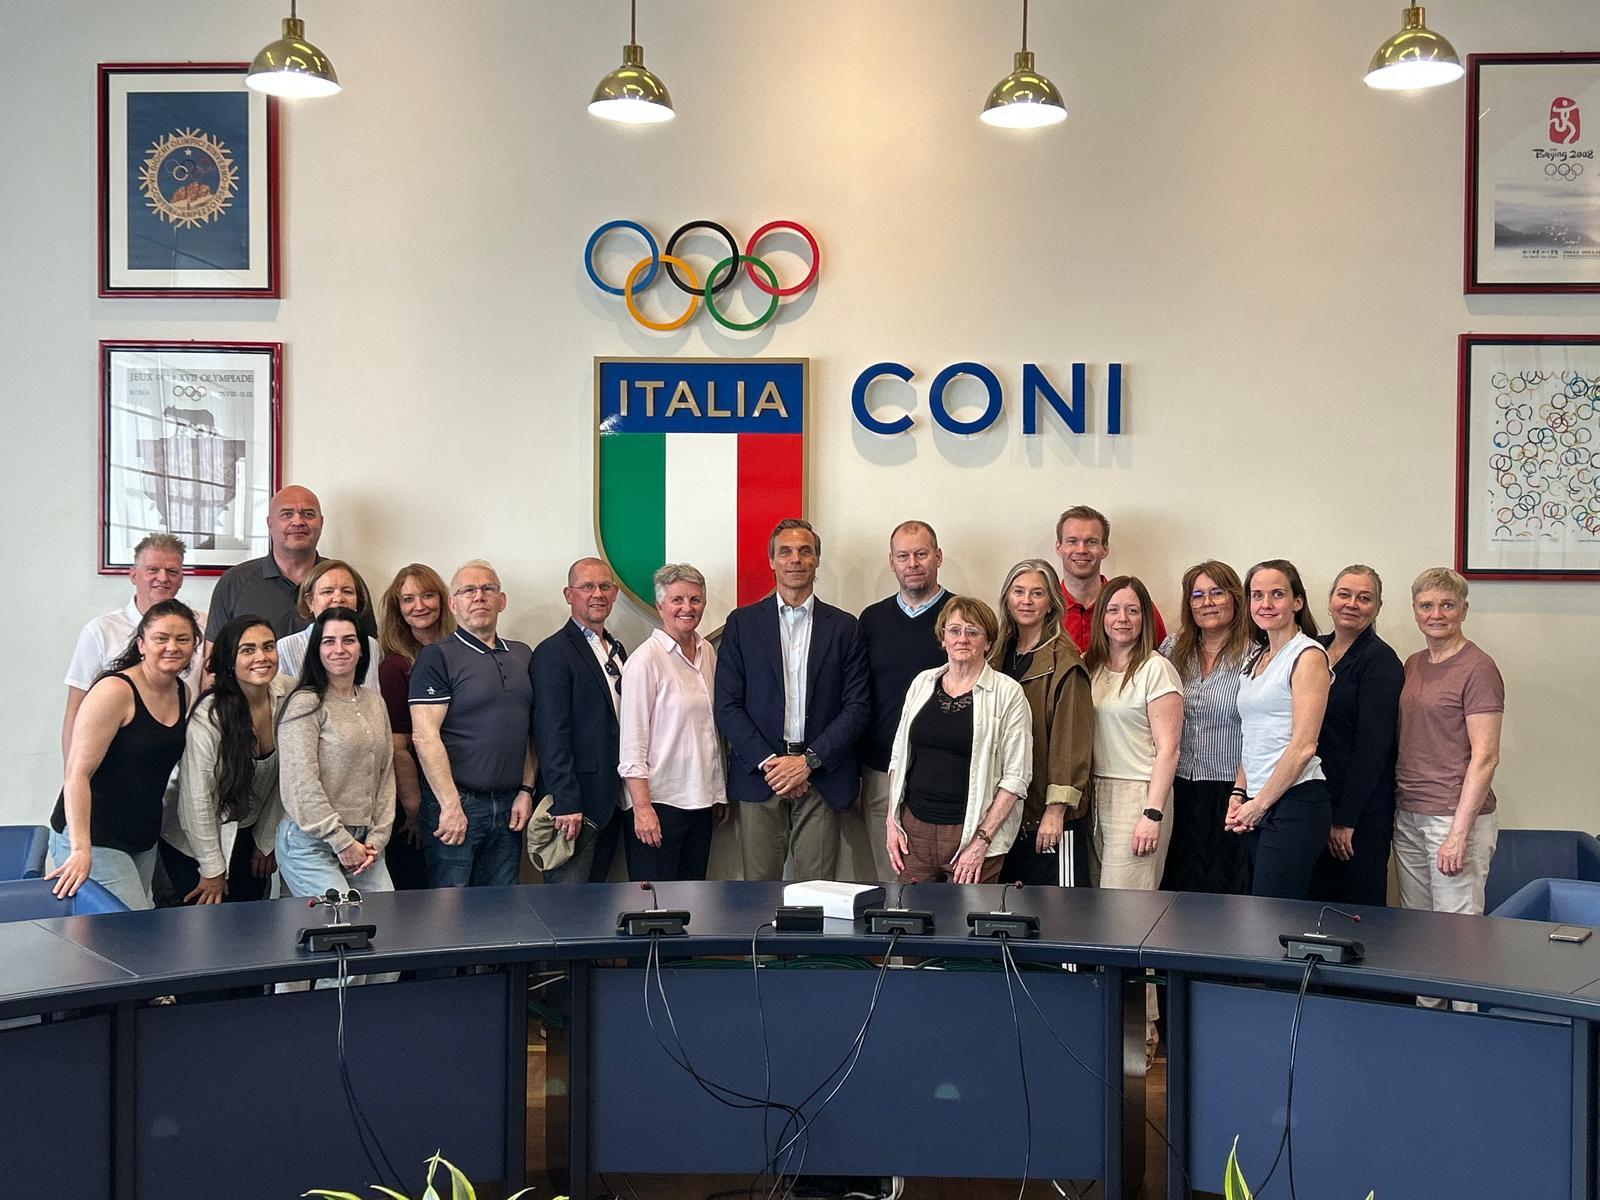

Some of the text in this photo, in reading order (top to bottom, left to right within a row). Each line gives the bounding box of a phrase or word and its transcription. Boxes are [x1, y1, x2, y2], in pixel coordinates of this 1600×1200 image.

[1532, 148, 1594, 161] Beijing 2008
[129, 373, 153, 382] JEUX
[200, 374, 254, 383] OLYMPIADE
[619, 378, 790, 419] ITALIA
[851, 362, 1122, 435] CONI
